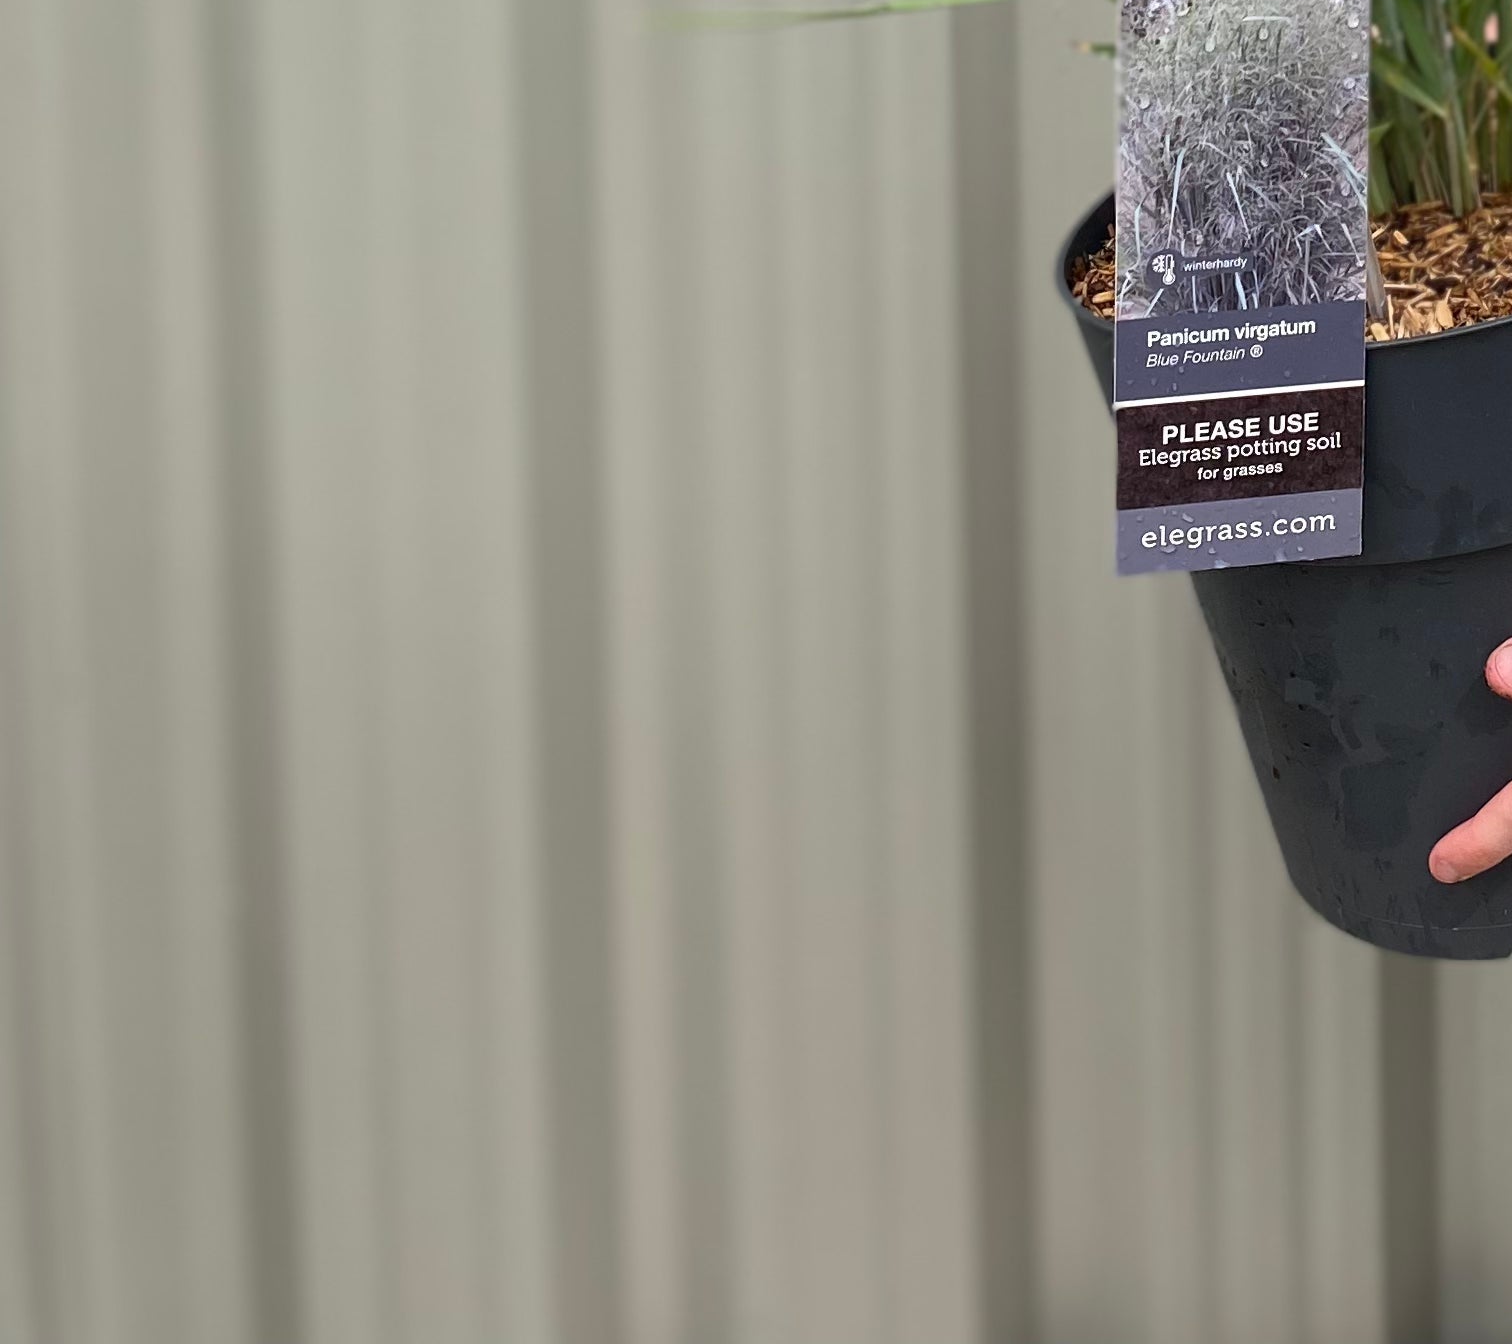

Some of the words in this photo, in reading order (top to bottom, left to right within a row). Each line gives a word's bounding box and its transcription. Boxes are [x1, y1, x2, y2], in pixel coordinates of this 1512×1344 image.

[1183, 256, 1247, 273] winterhardy
[1147, 325, 1230, 348] Panicum
[1234, 318, 1316, 341] virgatum
[1145, 352, 1179, 368] Blue
[1182, 348, 1246, 365] Fountain
[1162, 417, 1261, 445] PLEASE
[1268, 412, 1320, 435] USE
[1138, 445, 1222, 468] Elegrass
[1227, 437, 1302, 462] potting
[1306, 431, 1342, 450] soil
[1197, 467, 1219, 481] for
[1223, 461, 1284, 481] grasses
[1141, 513, 1337, 549] elegrass.com
